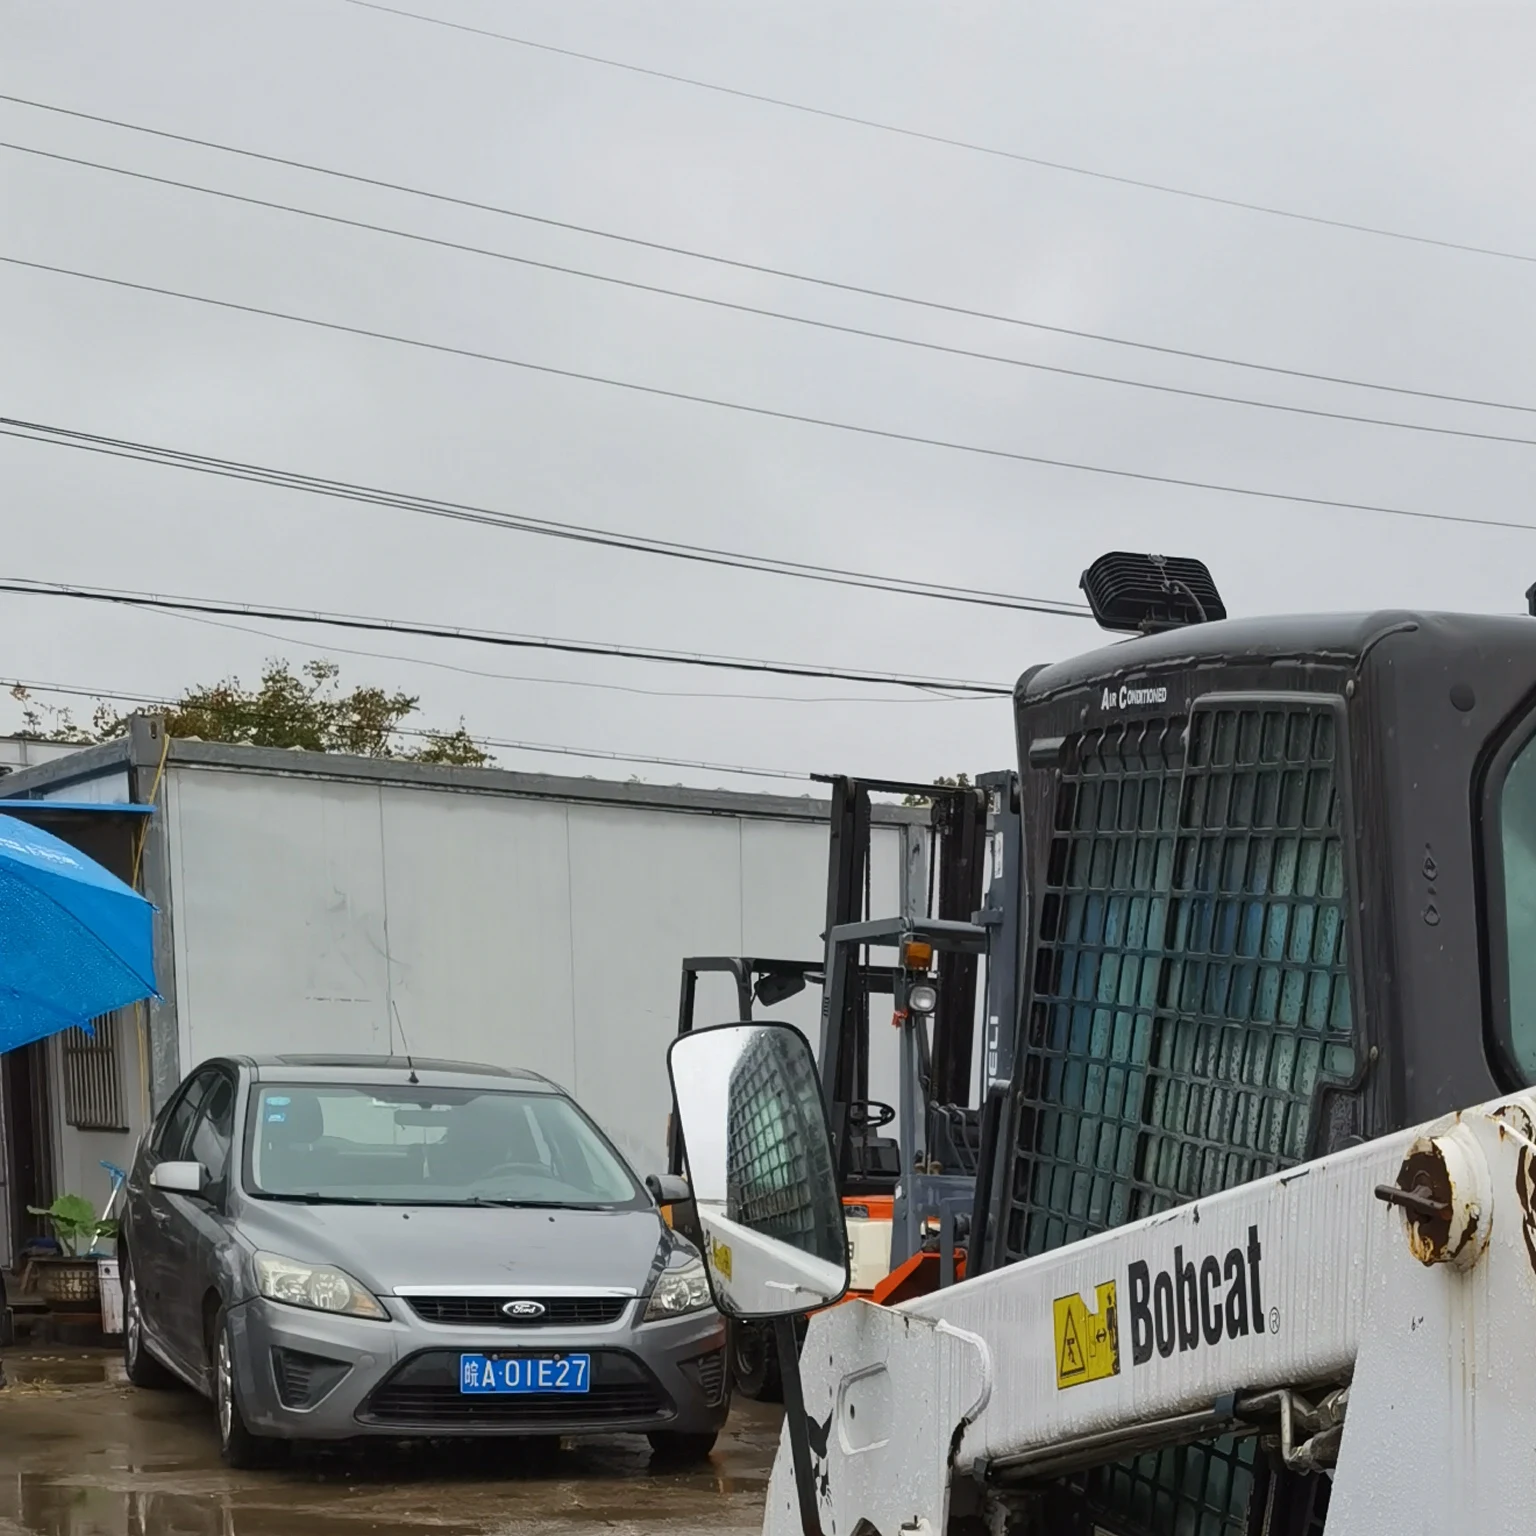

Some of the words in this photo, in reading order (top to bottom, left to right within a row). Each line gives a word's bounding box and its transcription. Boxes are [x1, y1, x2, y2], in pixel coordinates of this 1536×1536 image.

[1100, 687, 1117, 710] AIR
[1119, 685, 1167, 709] CONDITIONED
[988, 1015, 999, 1087] ELI
[512, 1303, 536, 1314] Ford
[1128, 1224, 1265, 1366] Bobcat
